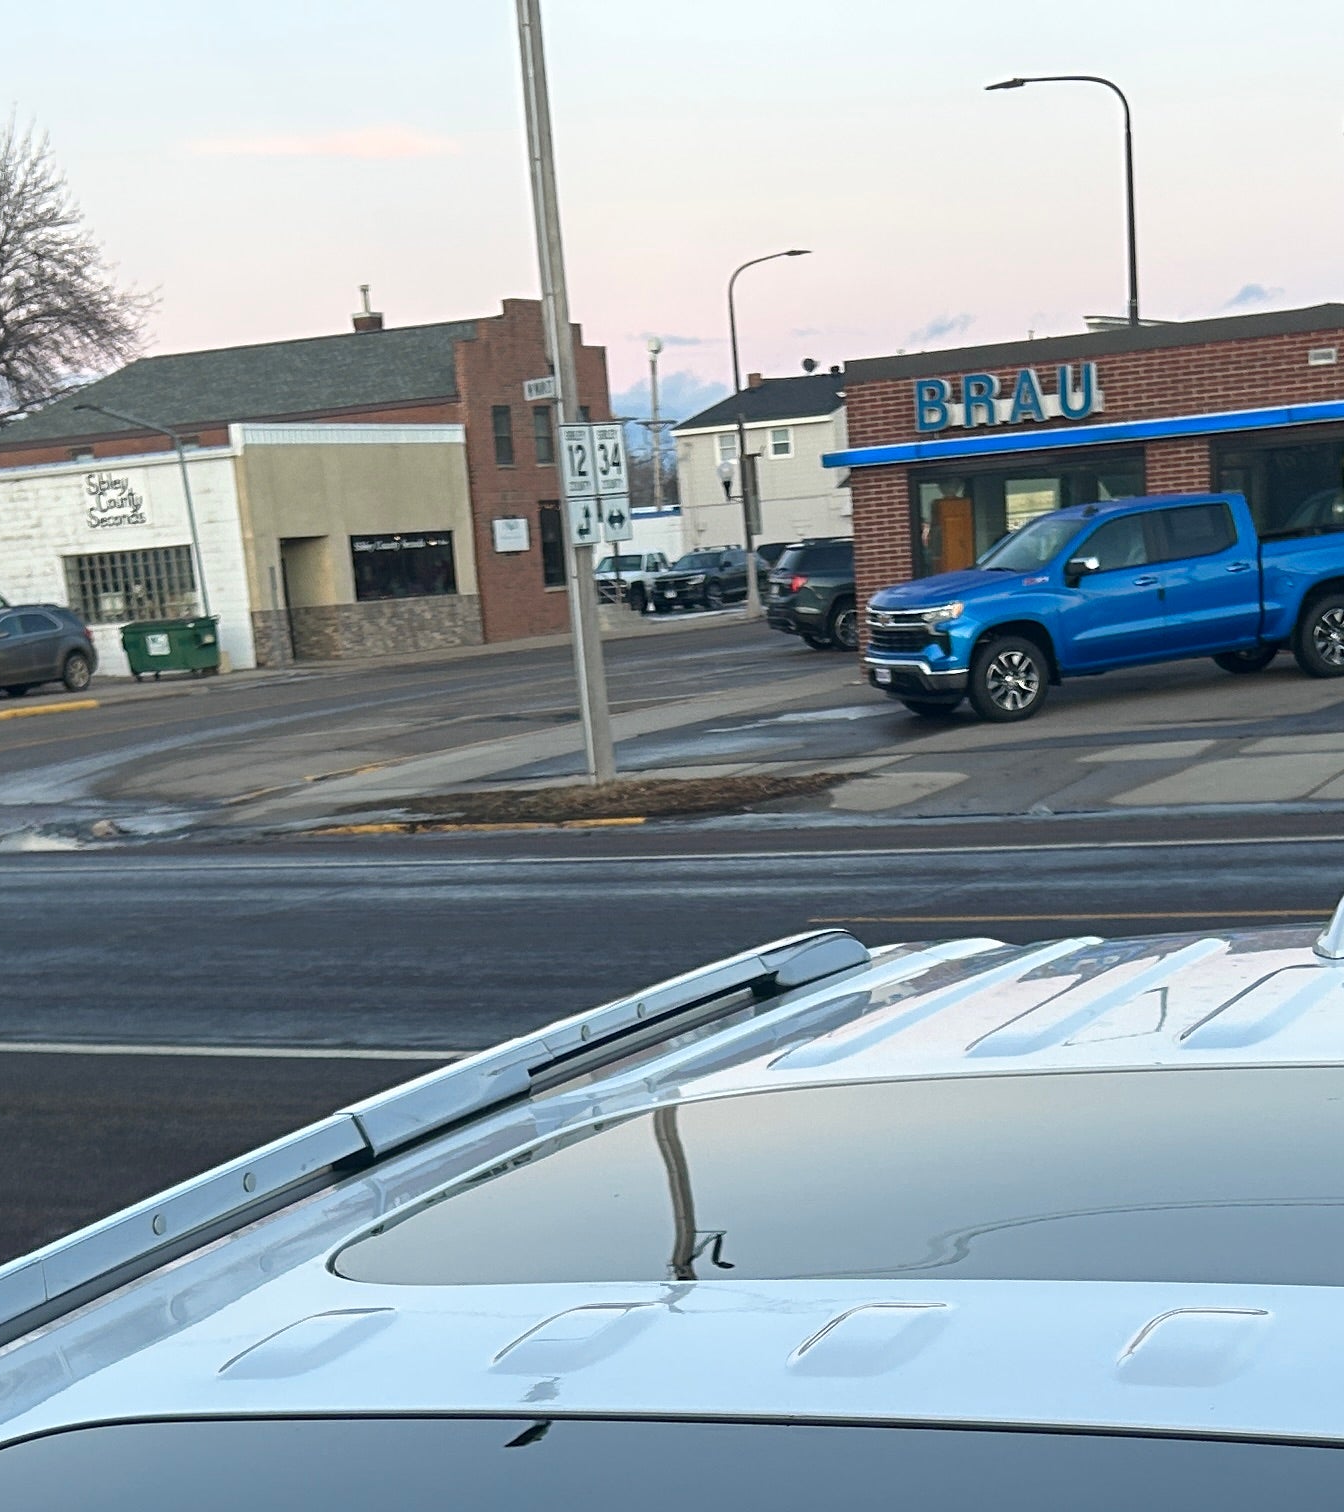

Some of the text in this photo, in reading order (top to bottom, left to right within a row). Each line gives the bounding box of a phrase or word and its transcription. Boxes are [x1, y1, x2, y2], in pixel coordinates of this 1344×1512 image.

[914, 362, 1098, 432] BRAU
[567, 444, 588, 477] 12
[598, 443, 622, 476] 34
[85, 472, 128, 496] Sibley
[96, 488, 143, 512] County
[86, 507, 147, 528] Seconds
